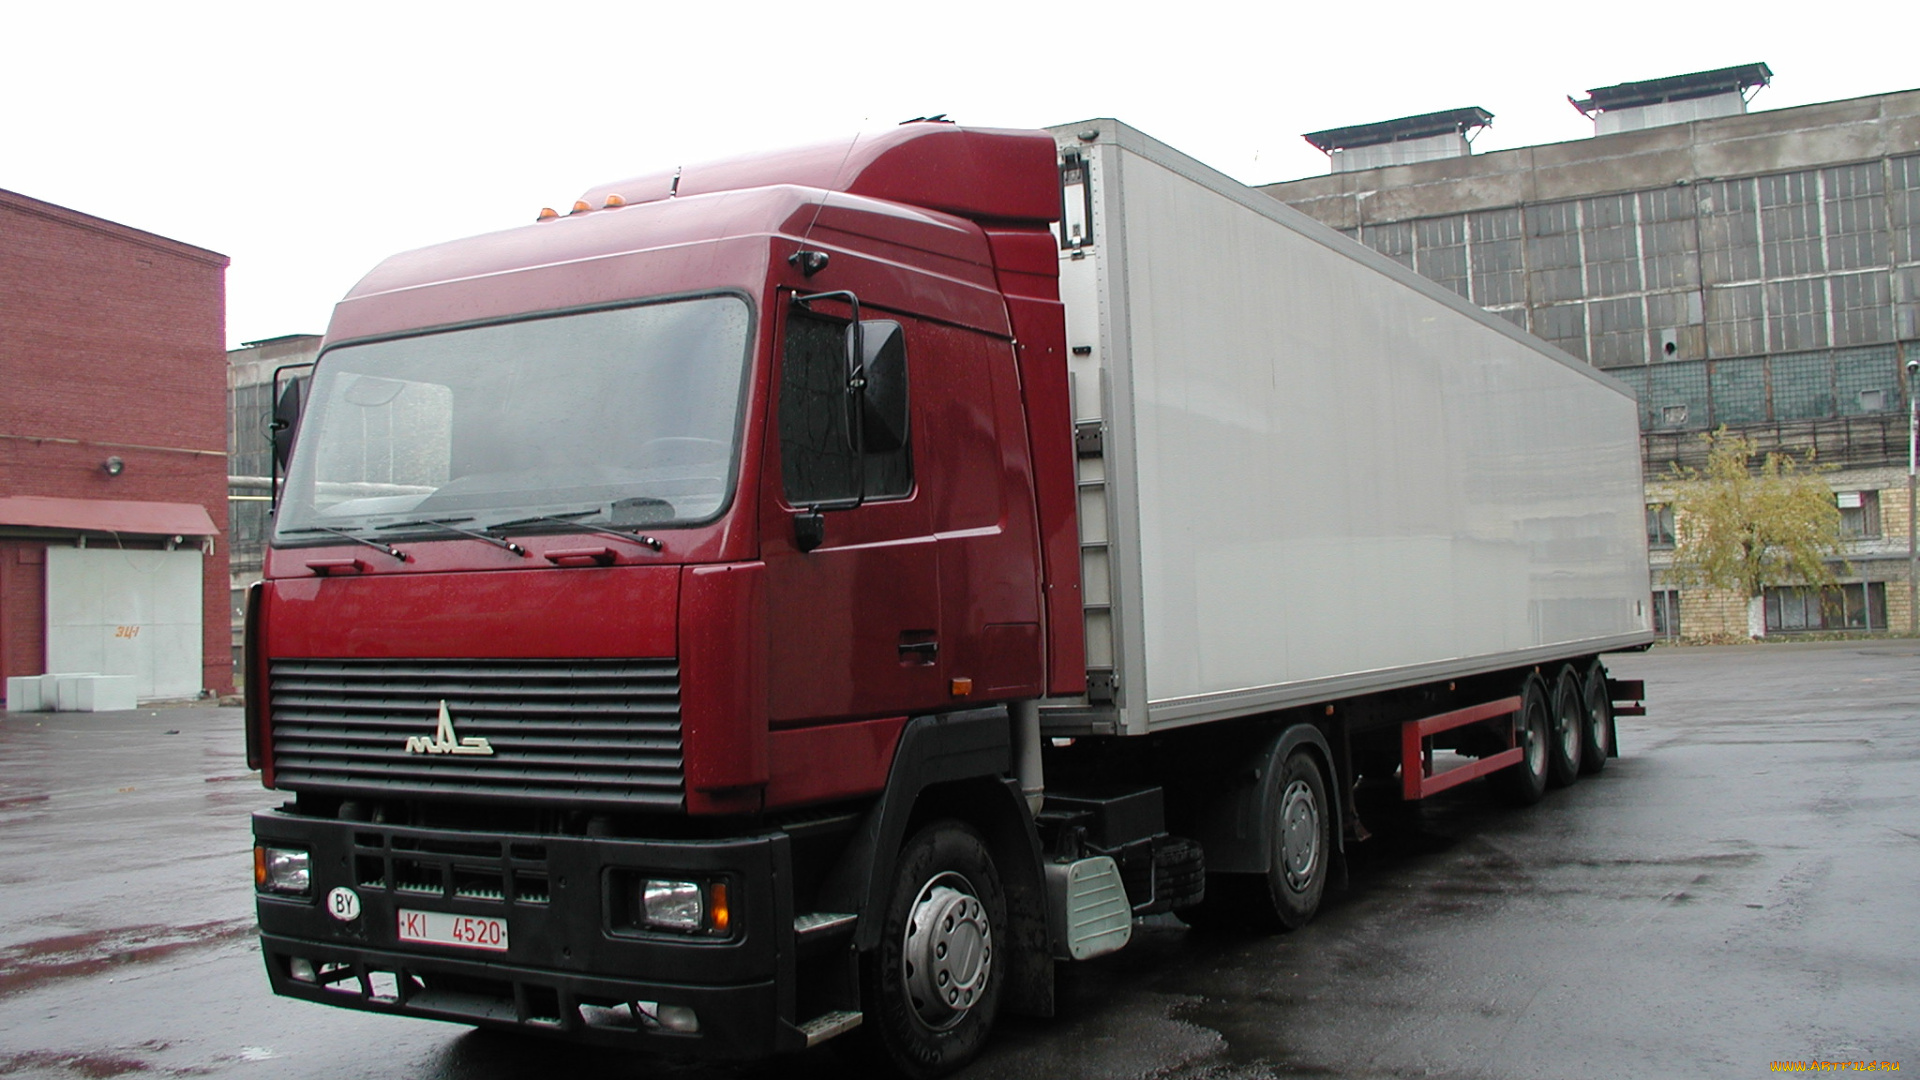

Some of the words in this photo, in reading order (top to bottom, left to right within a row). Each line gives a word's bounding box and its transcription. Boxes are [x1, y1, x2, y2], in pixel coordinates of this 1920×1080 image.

[335, 893, 353, 914] BY
[407, 912, 427, 938] KI
[453, 917, 501, 945] 4520
